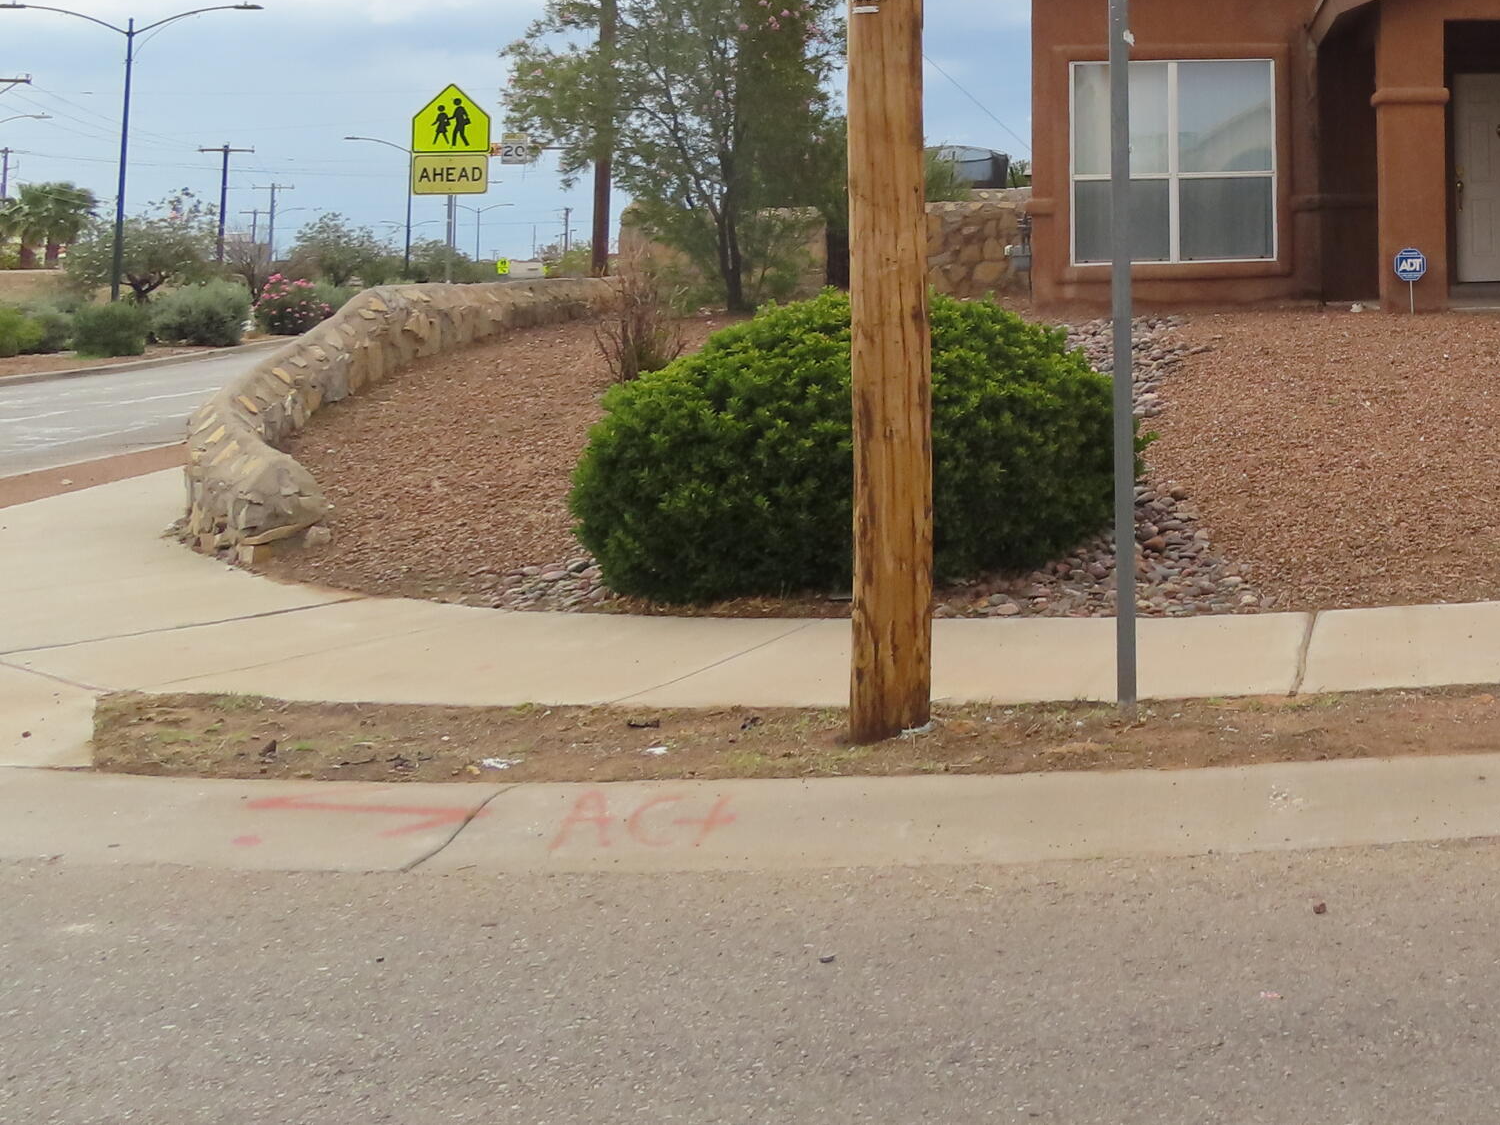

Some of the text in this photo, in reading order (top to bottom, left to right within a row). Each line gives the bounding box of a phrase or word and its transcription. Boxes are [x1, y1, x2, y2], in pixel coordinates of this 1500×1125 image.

[503, 145, 525, 157] 20
[418, 167, 483, 182] AHEAD
[1399, 259, 1422, 272] ADT
